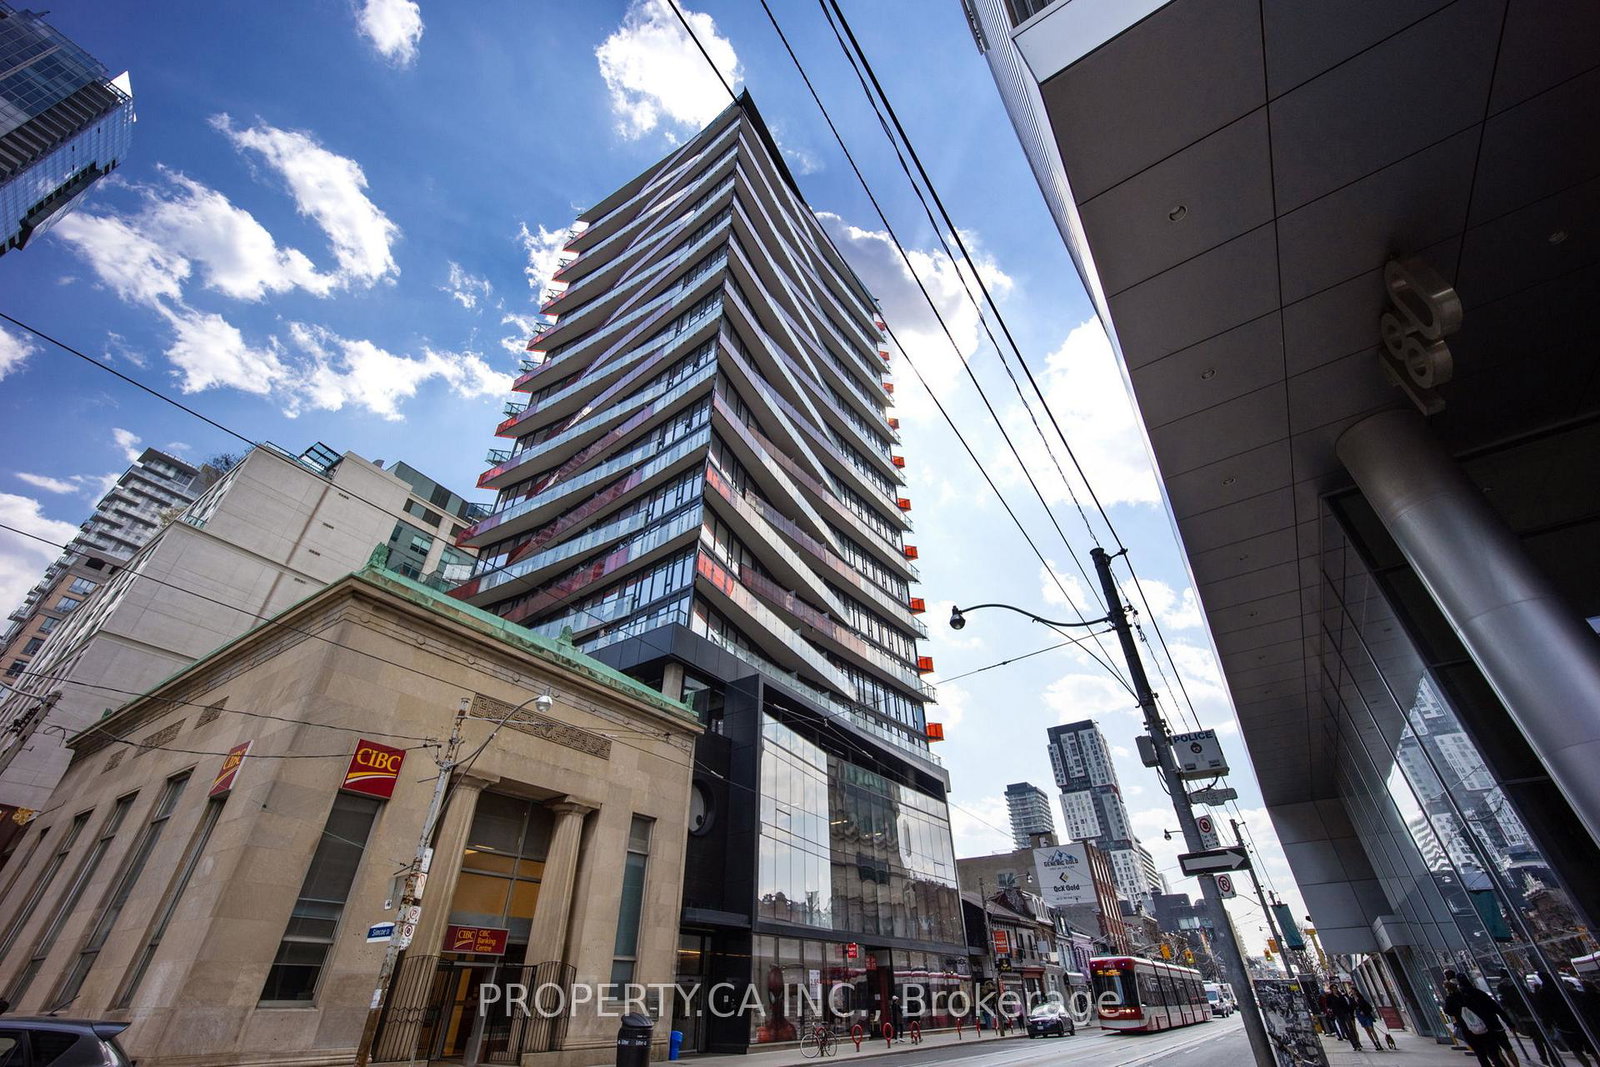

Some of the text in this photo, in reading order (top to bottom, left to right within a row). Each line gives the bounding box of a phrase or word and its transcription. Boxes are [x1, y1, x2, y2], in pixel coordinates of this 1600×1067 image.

[1173, 730, 1213, 743] POLICE
[356, 747, 402, 772] CIBC
[458, 930, 475, 939] CIBC
